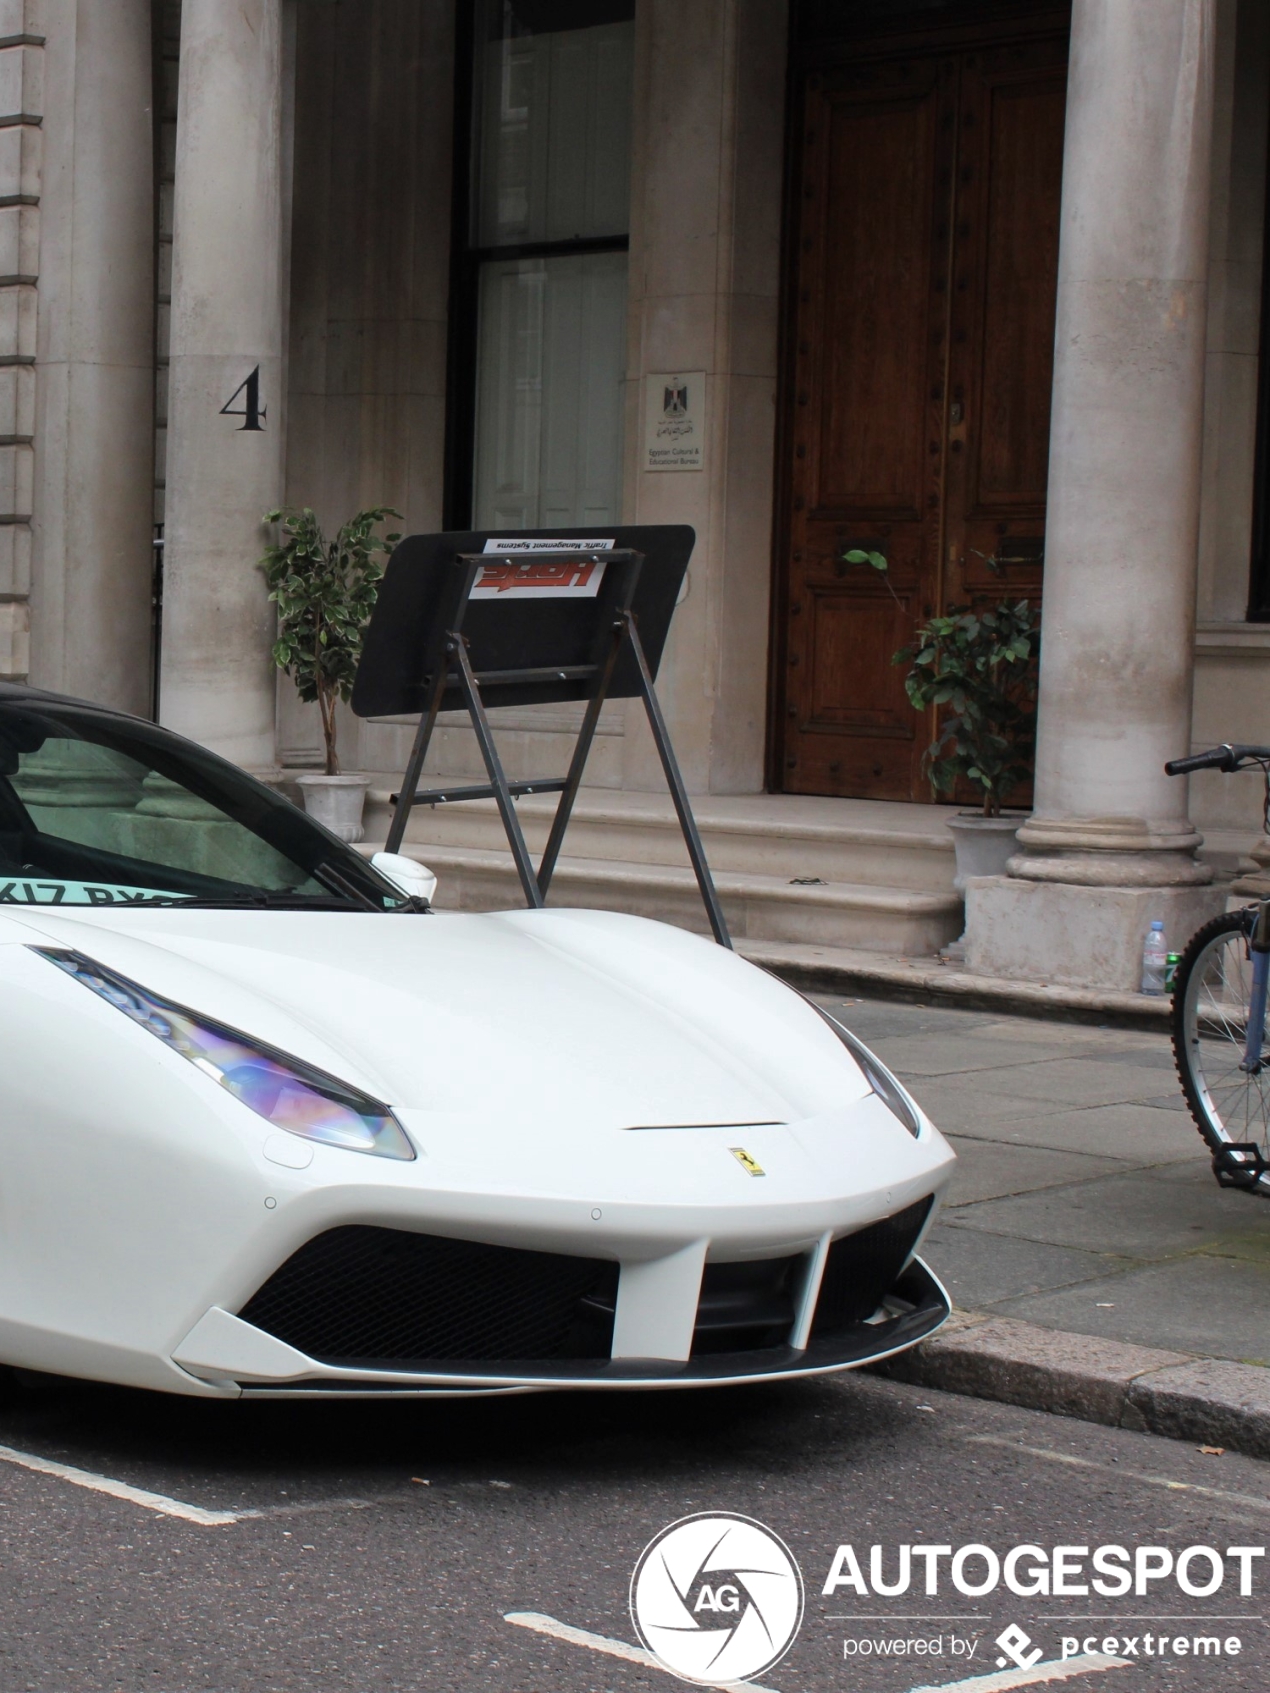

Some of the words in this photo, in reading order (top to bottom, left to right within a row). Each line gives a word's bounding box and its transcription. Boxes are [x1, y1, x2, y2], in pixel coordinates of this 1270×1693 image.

[219, 364, 267, 431] 4
[649, 449, 670, 457] Egyptian
[496, 541, 531, 550] Systems
